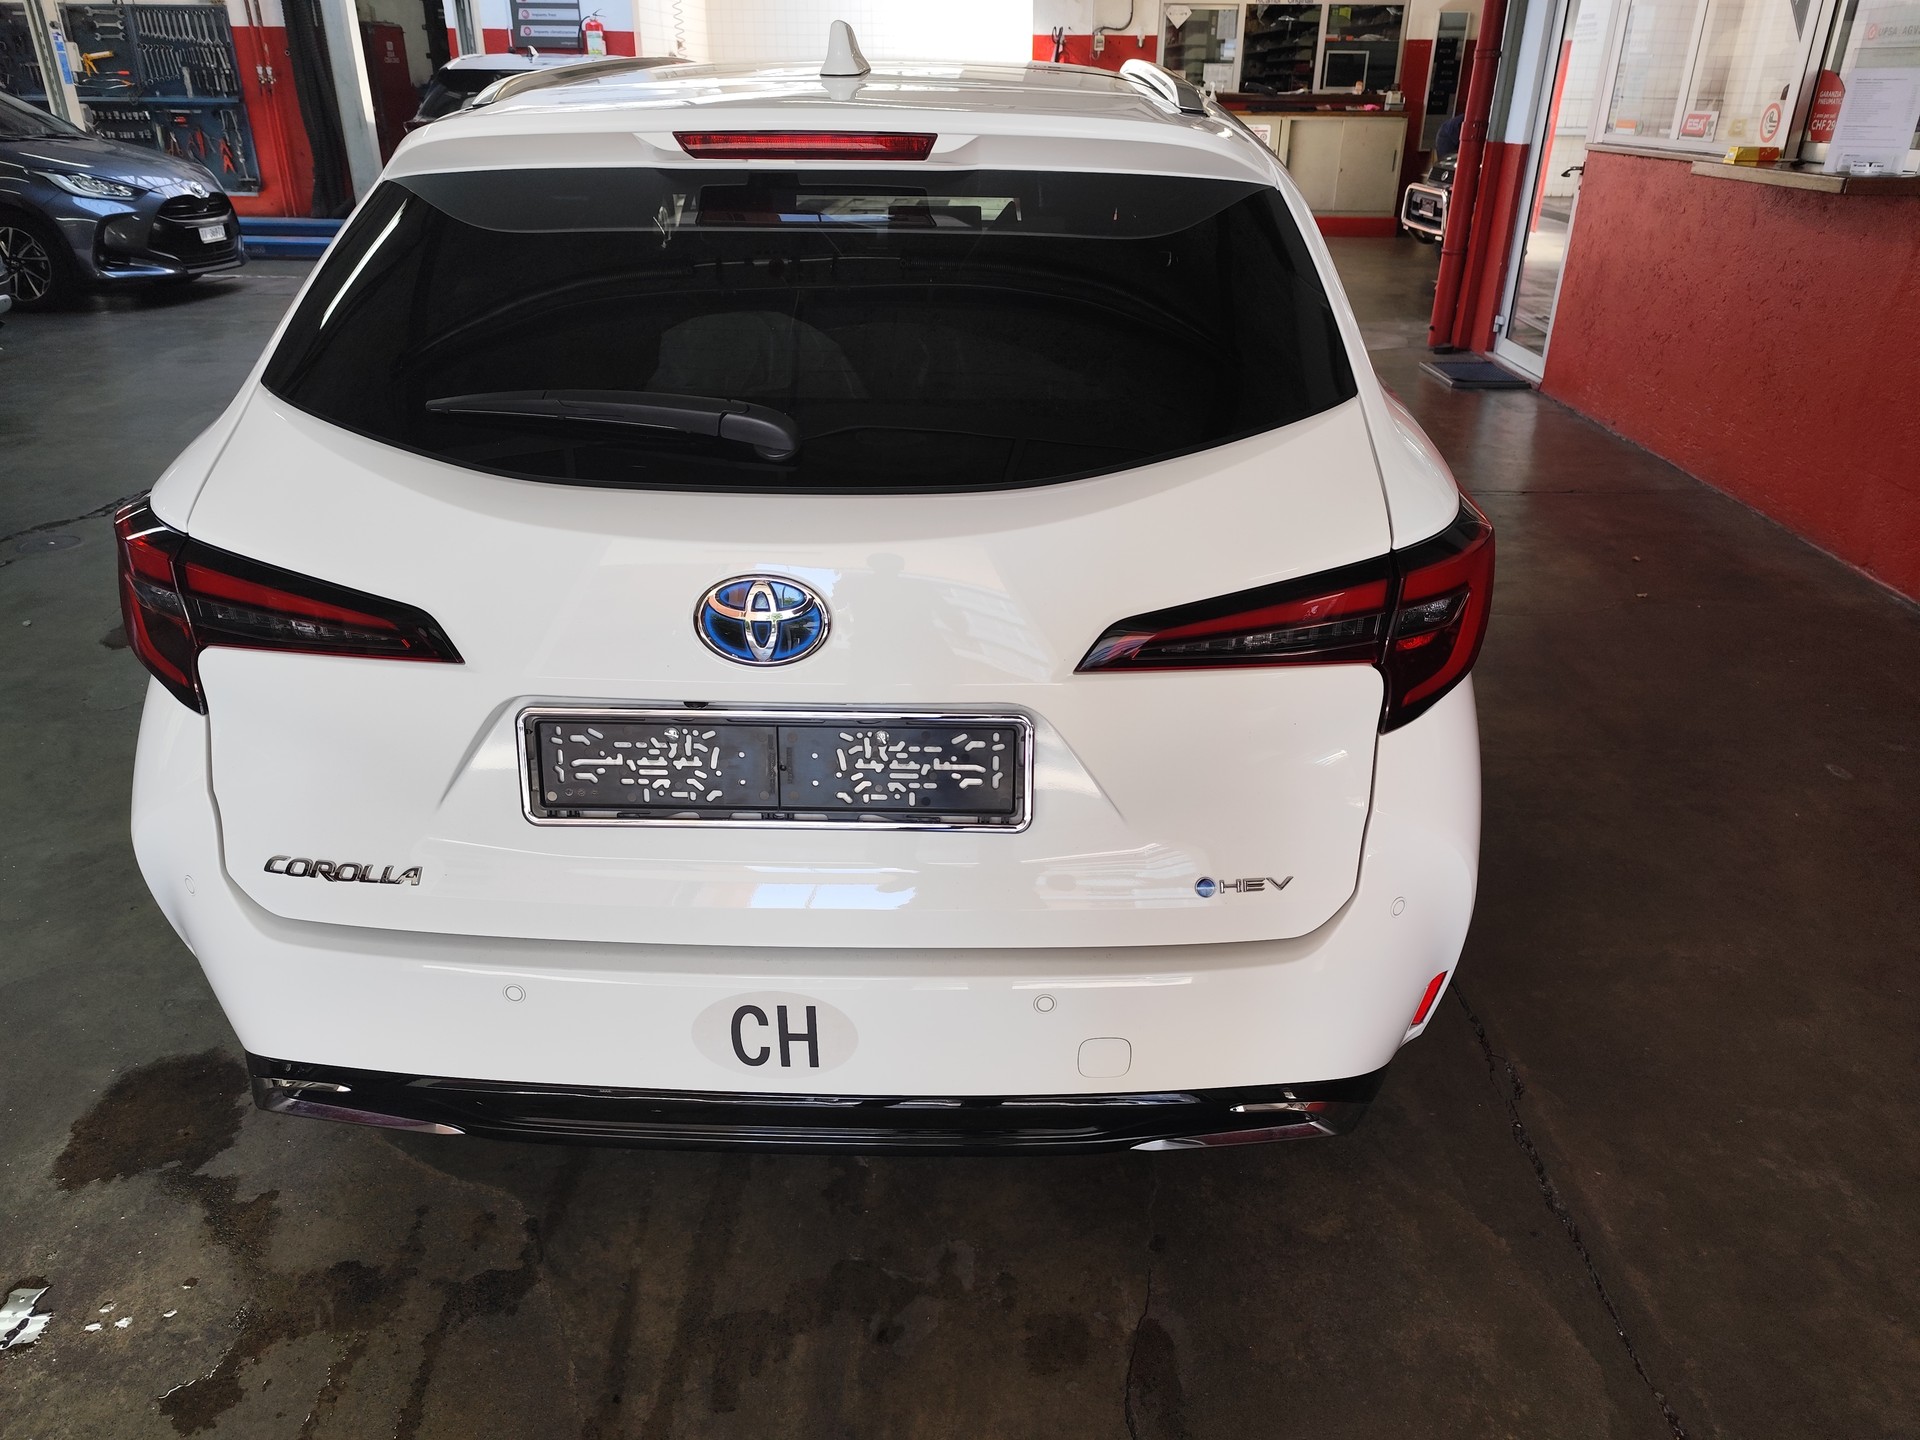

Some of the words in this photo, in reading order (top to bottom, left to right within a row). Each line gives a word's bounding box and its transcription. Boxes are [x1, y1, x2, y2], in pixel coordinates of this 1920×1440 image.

[1812, 120, 1826, 130] CHF
[264, 855, 423, 886] COROLLA
[1219, 876, 1294, 894] HEV
[731, 1005, 819, 1068] CH
